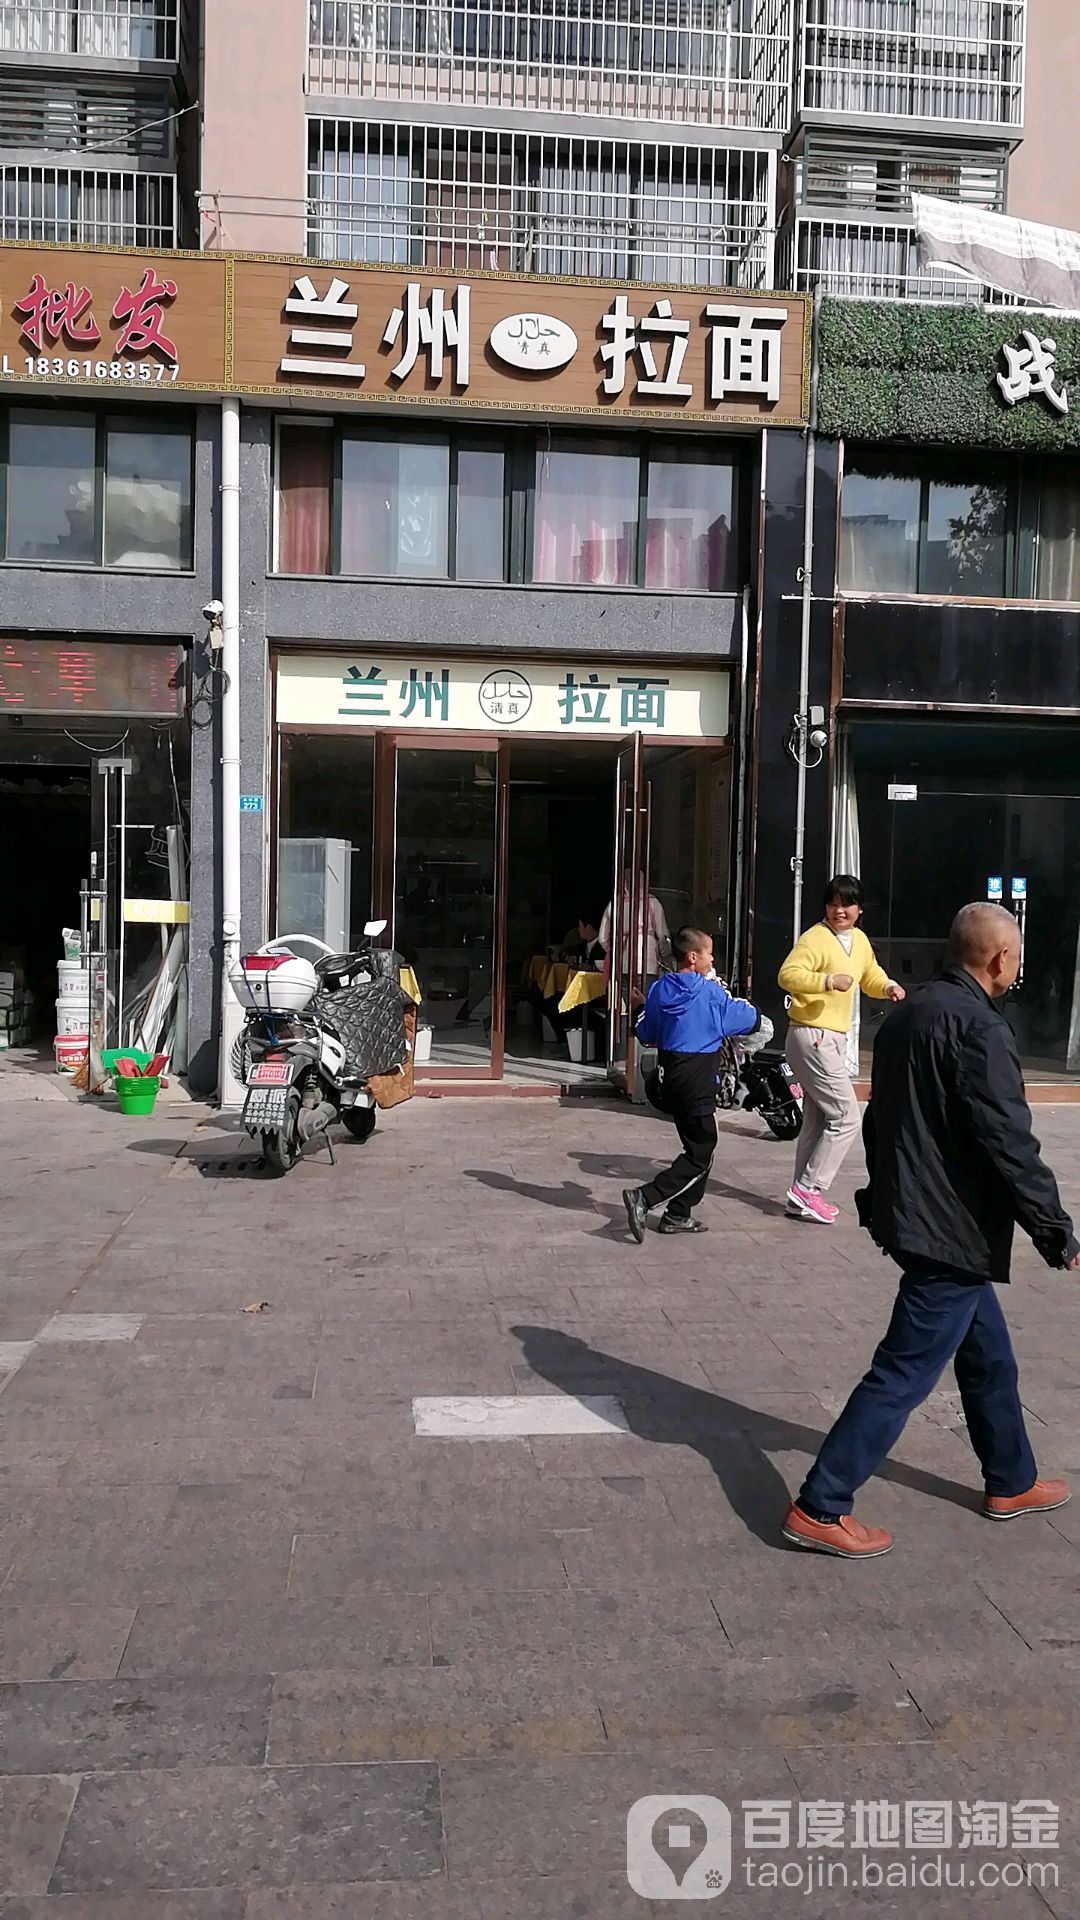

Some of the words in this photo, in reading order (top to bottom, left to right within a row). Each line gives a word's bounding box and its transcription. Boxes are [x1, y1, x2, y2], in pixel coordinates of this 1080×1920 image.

[13, 267, 178, 363] 批发
[280, 275, 472, 386] 兰州
[599, 294, 788, 402] 拉面
[24, 356, 180, 381] 18361683577
[997, 330, 1069, 414] 战
[338, 666, 450, 721] 兰州
[557, 672, 671, 728] 拉面
